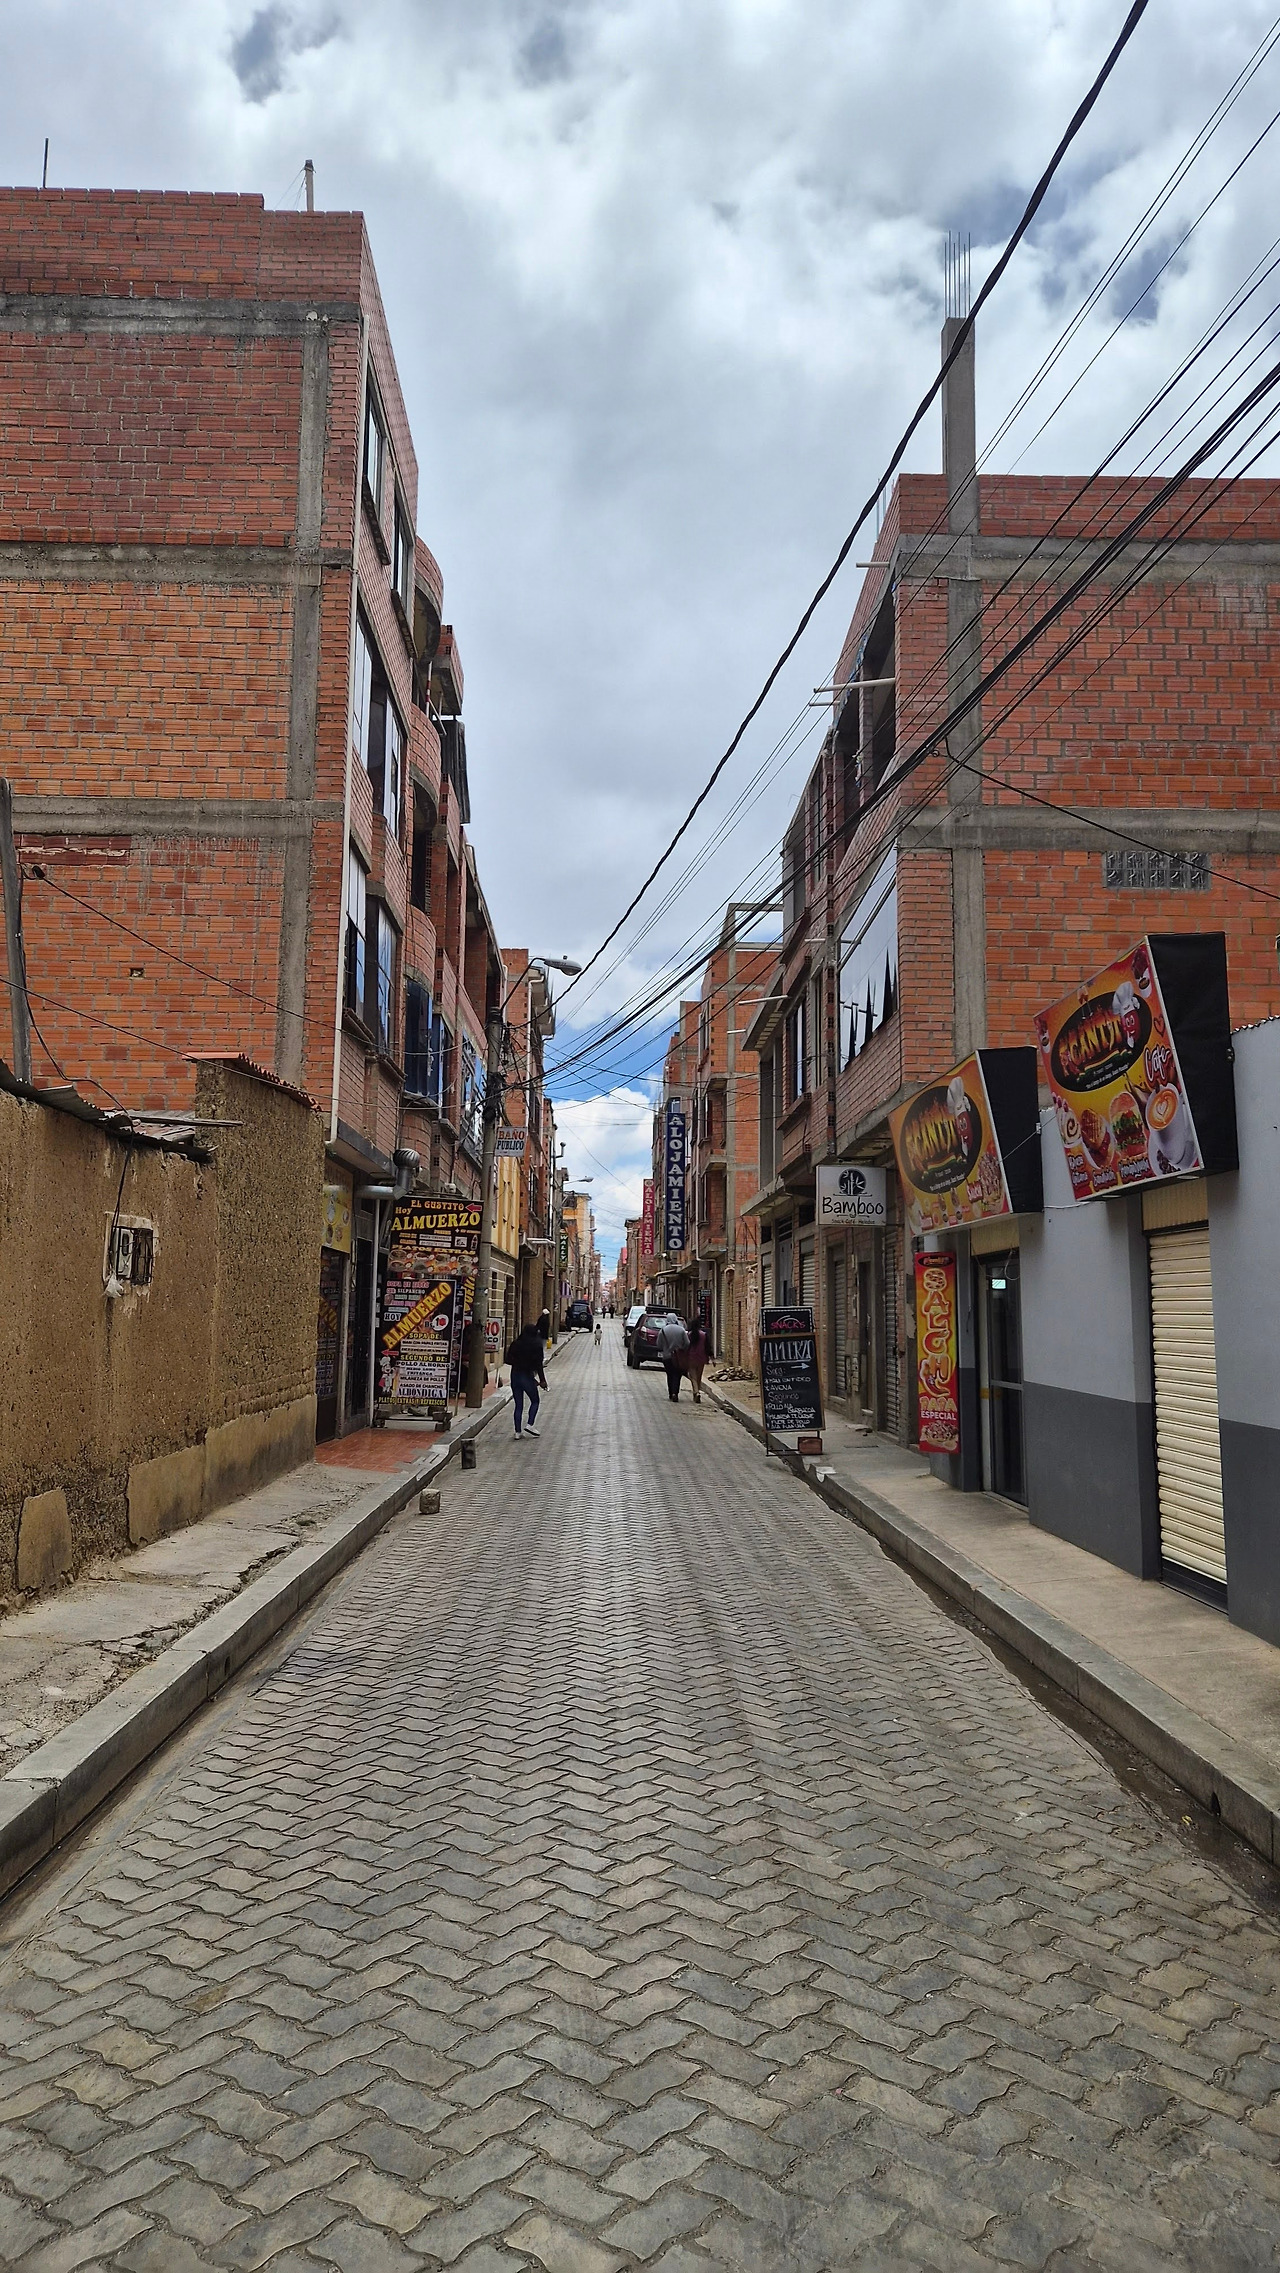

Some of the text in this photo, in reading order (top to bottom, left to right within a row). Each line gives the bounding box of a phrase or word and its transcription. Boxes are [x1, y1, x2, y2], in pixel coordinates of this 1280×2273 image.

[498, 1129, 525, 1140] BAÑO
[668, 1115, 684, 1249] ALOJAMIENTO
[395, 1207, 413, 1215] Hoy
[411, 1200, 422, 1208] EL
[822, 1196, 884, 1219] Bamboo
[390, 1212, 481, 1231] ALMUERZO
[644, 1186, 654, 1255] ALOJAMIENTO
[560, 1235, 569, 1260] WALLY
[383, 1282, 452, 1350] ALMUERZO
[384, 1313, 402, 1321] HOY
[398, 1388, 444, 1398] ALBONDIGA
[919, 1397, 957, 1413] PAPA
[920, 1410, 957, 1421] ESPECIAL
